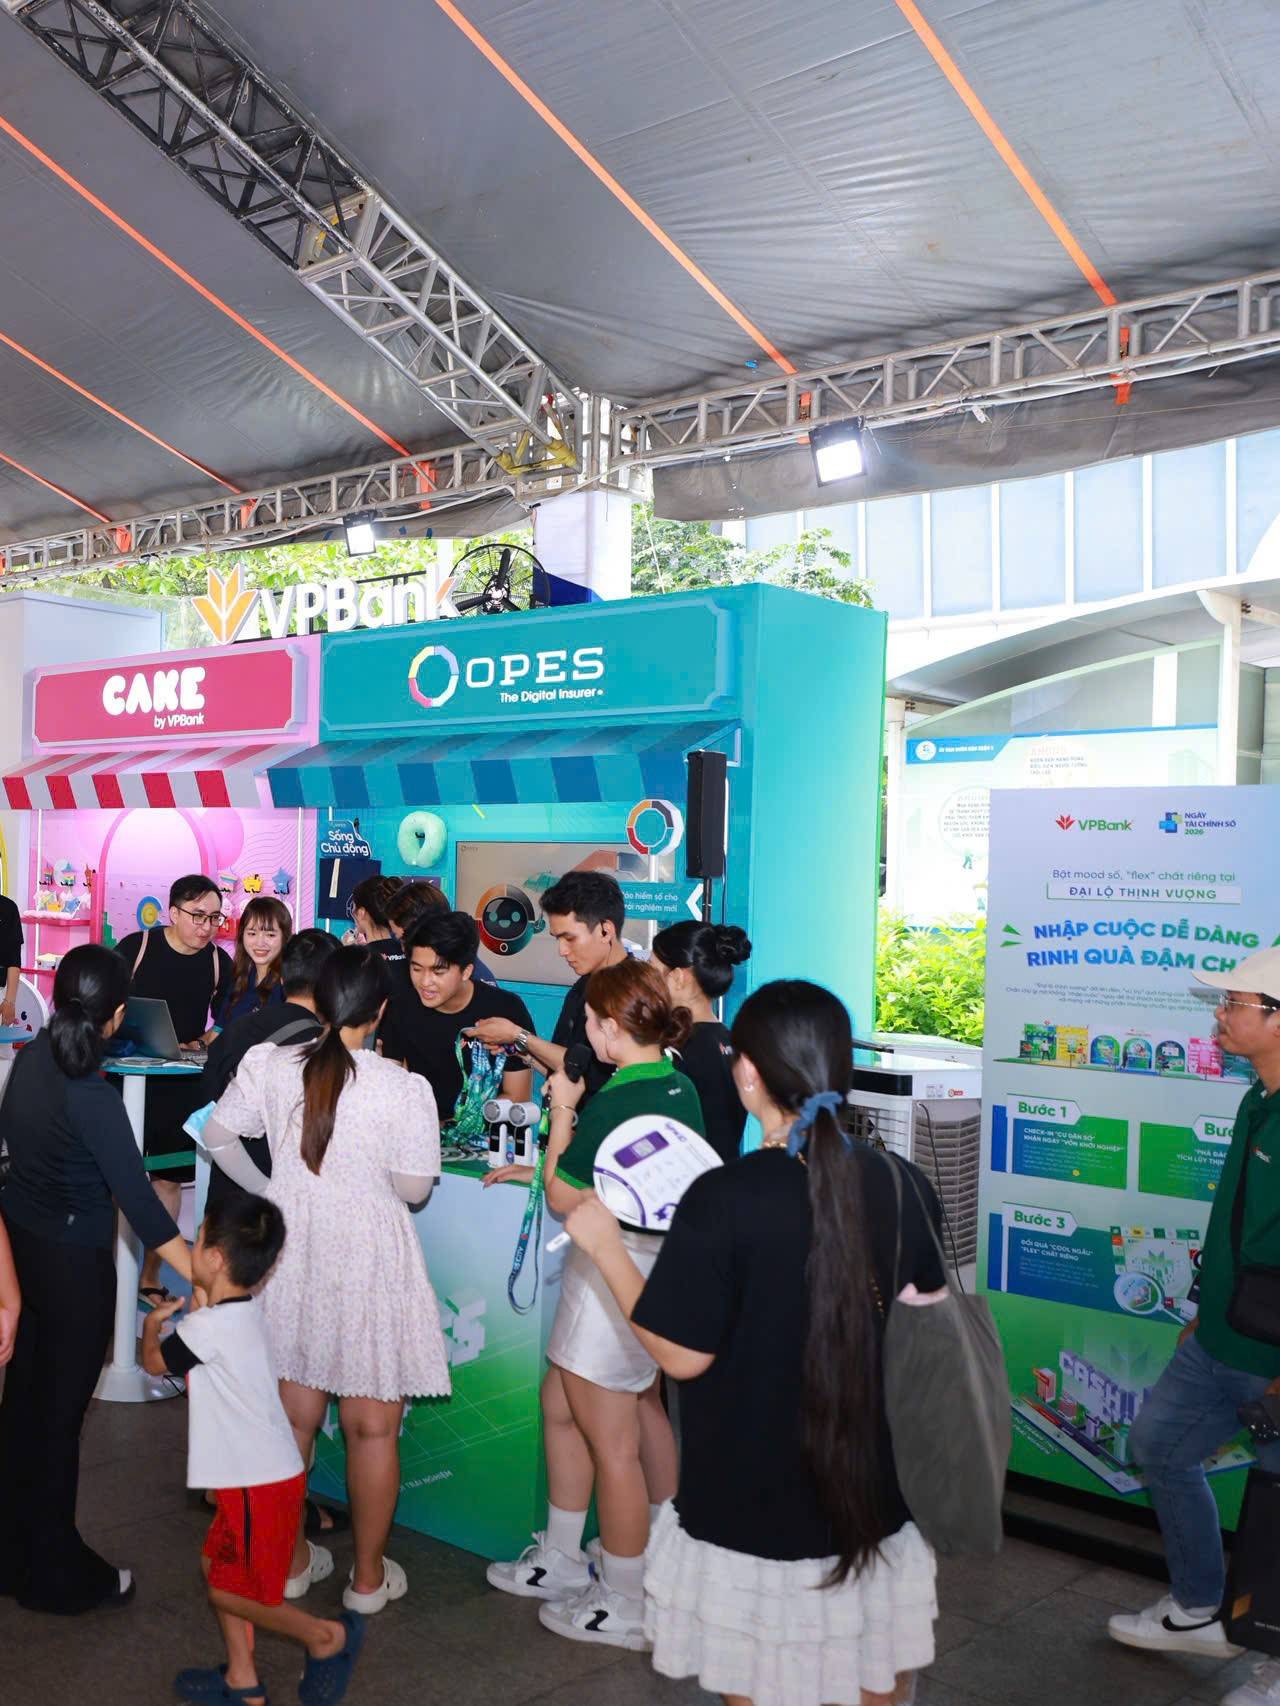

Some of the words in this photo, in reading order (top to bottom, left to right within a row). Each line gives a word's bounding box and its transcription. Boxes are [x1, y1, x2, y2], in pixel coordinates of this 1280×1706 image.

[258, 563, 461, 639] VPBank
[465, 647, 604, 688] OPES
[102, 667, 206, 716] CAKE
[500, 692, 519, 703] The
[521, 688, 556, 704] Digital
[153, 715, 166, 730] by
[167, 712, 205, 727] VPBank
[1184, 811, 1207, 819] NGÀY
[1198, 819, 1223, 828] CHÍNH
[1224, 818, 1236, 828] SỐ
[1078, 818, 1134, 832] VPBank
[328, 829, 355, 844] Sống
[321, 842, 341, 854] Chủ
[342, 842, 369, 857] động
[1074, 870, 1105, 879] mood
[1158, 869, 1186, 881] chất
[1187, 870, 1216, 883] riêng
[1220, 872, 1235, 883] tại
[1069, 886, 1092, 899] ĐẠI
[1097, 885, 1114, 899] LỘ
[1119, 887, 1159, 900] THỊNH
[1165, 888, 1217, 901] VƯỢNG
[1033, 919, 1089, 941] NHẬP
[1093, 918, 1156, 940] CUỘC
[1161, 918, 1190, 940] DỄ
[1194, 923, 1260, 949] DÀNG
[1026, 949, 1079, 967] RINH
[1084, 944, 1135, 966] QUÀ
[1141, 948, 1196, 972] ĐẬM
[1201, 955, 1239, 973] CH
[1018, 1101, 1056, 1117] Bước
[1060, 1106, 1067, 1118] 1
[1023, 1127, 1054, 1136] CHECK-IN
[1209, 1157, 1225, 1166] THỊN
[1014, 1210, 1052, 1227] Bước
[1056, 1216, 1066, 1229] 3
